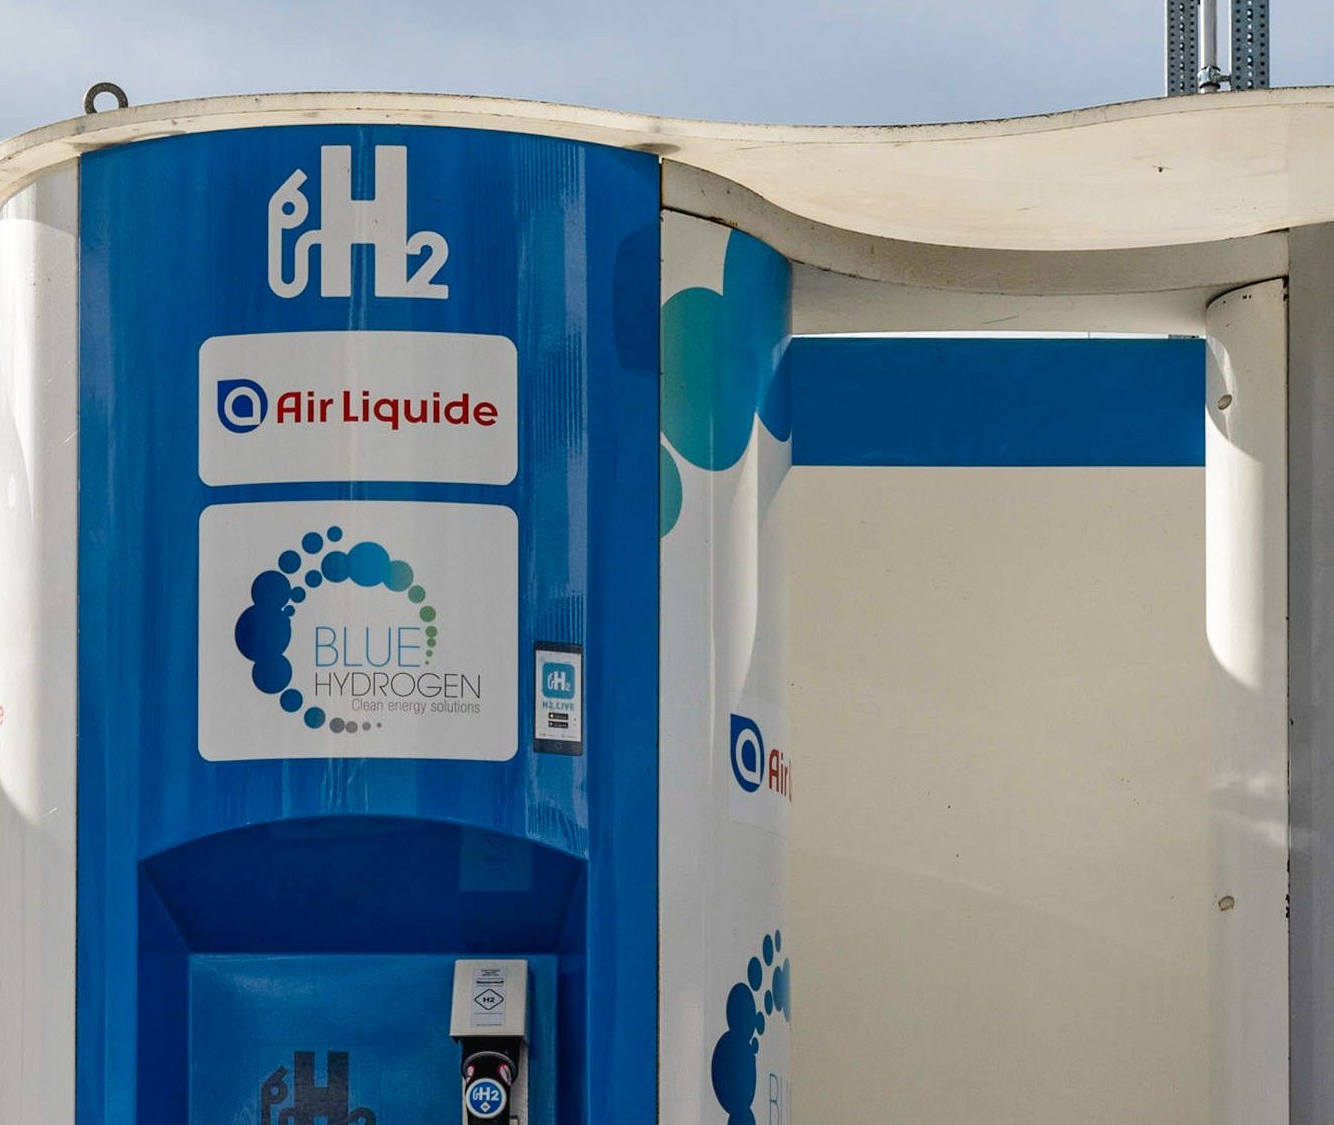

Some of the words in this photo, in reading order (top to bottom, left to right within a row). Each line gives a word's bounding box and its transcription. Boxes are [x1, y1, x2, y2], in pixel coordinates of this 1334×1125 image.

[277, 391, 334, 424] Air
[344, 391, 498, 430] Liquide
[315, 626, 421, 668] BLUE
[315, 672, 481, 698] HYDROGEN
[352, 699, 384, 712] Clean
[388, 701, 427, 716] energy
[430, 700, 481, 714] solutions
[769, 749, 788, 797] Air
[482, 996, 496, 1004] H2
